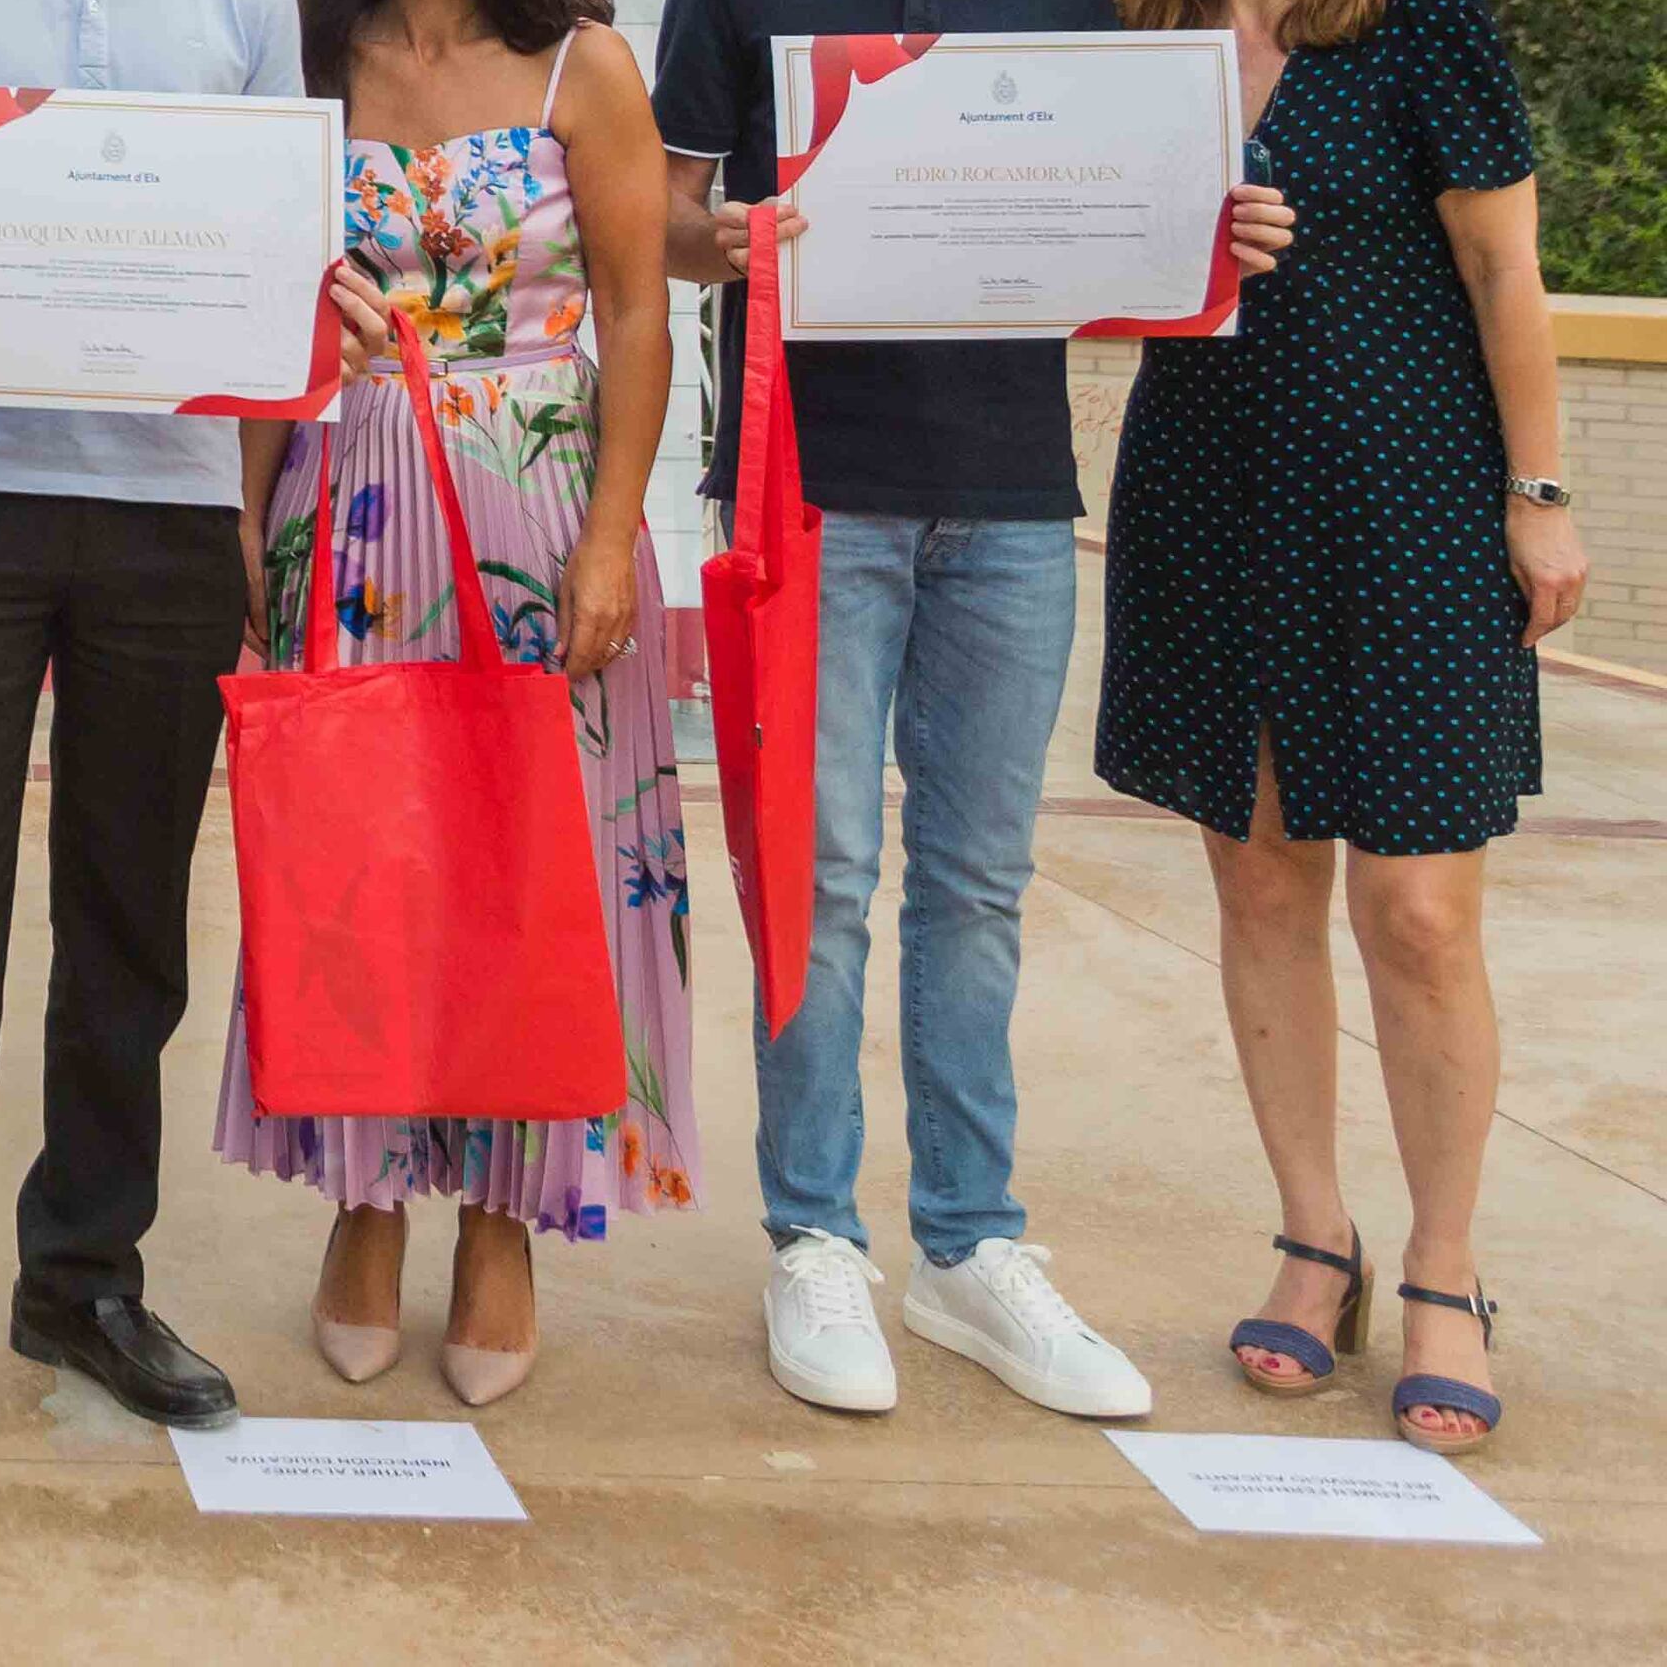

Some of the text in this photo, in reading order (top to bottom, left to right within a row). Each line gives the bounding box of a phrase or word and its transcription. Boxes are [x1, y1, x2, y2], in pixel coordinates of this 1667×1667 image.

[959, 111, 1054, 125] Ajuntament d'Elx
[66, 169, 133, 183] Ajuntament
[894, 166, 957, 183] PEDRO
[961, 166, 1072, 183] ROCAMORA
